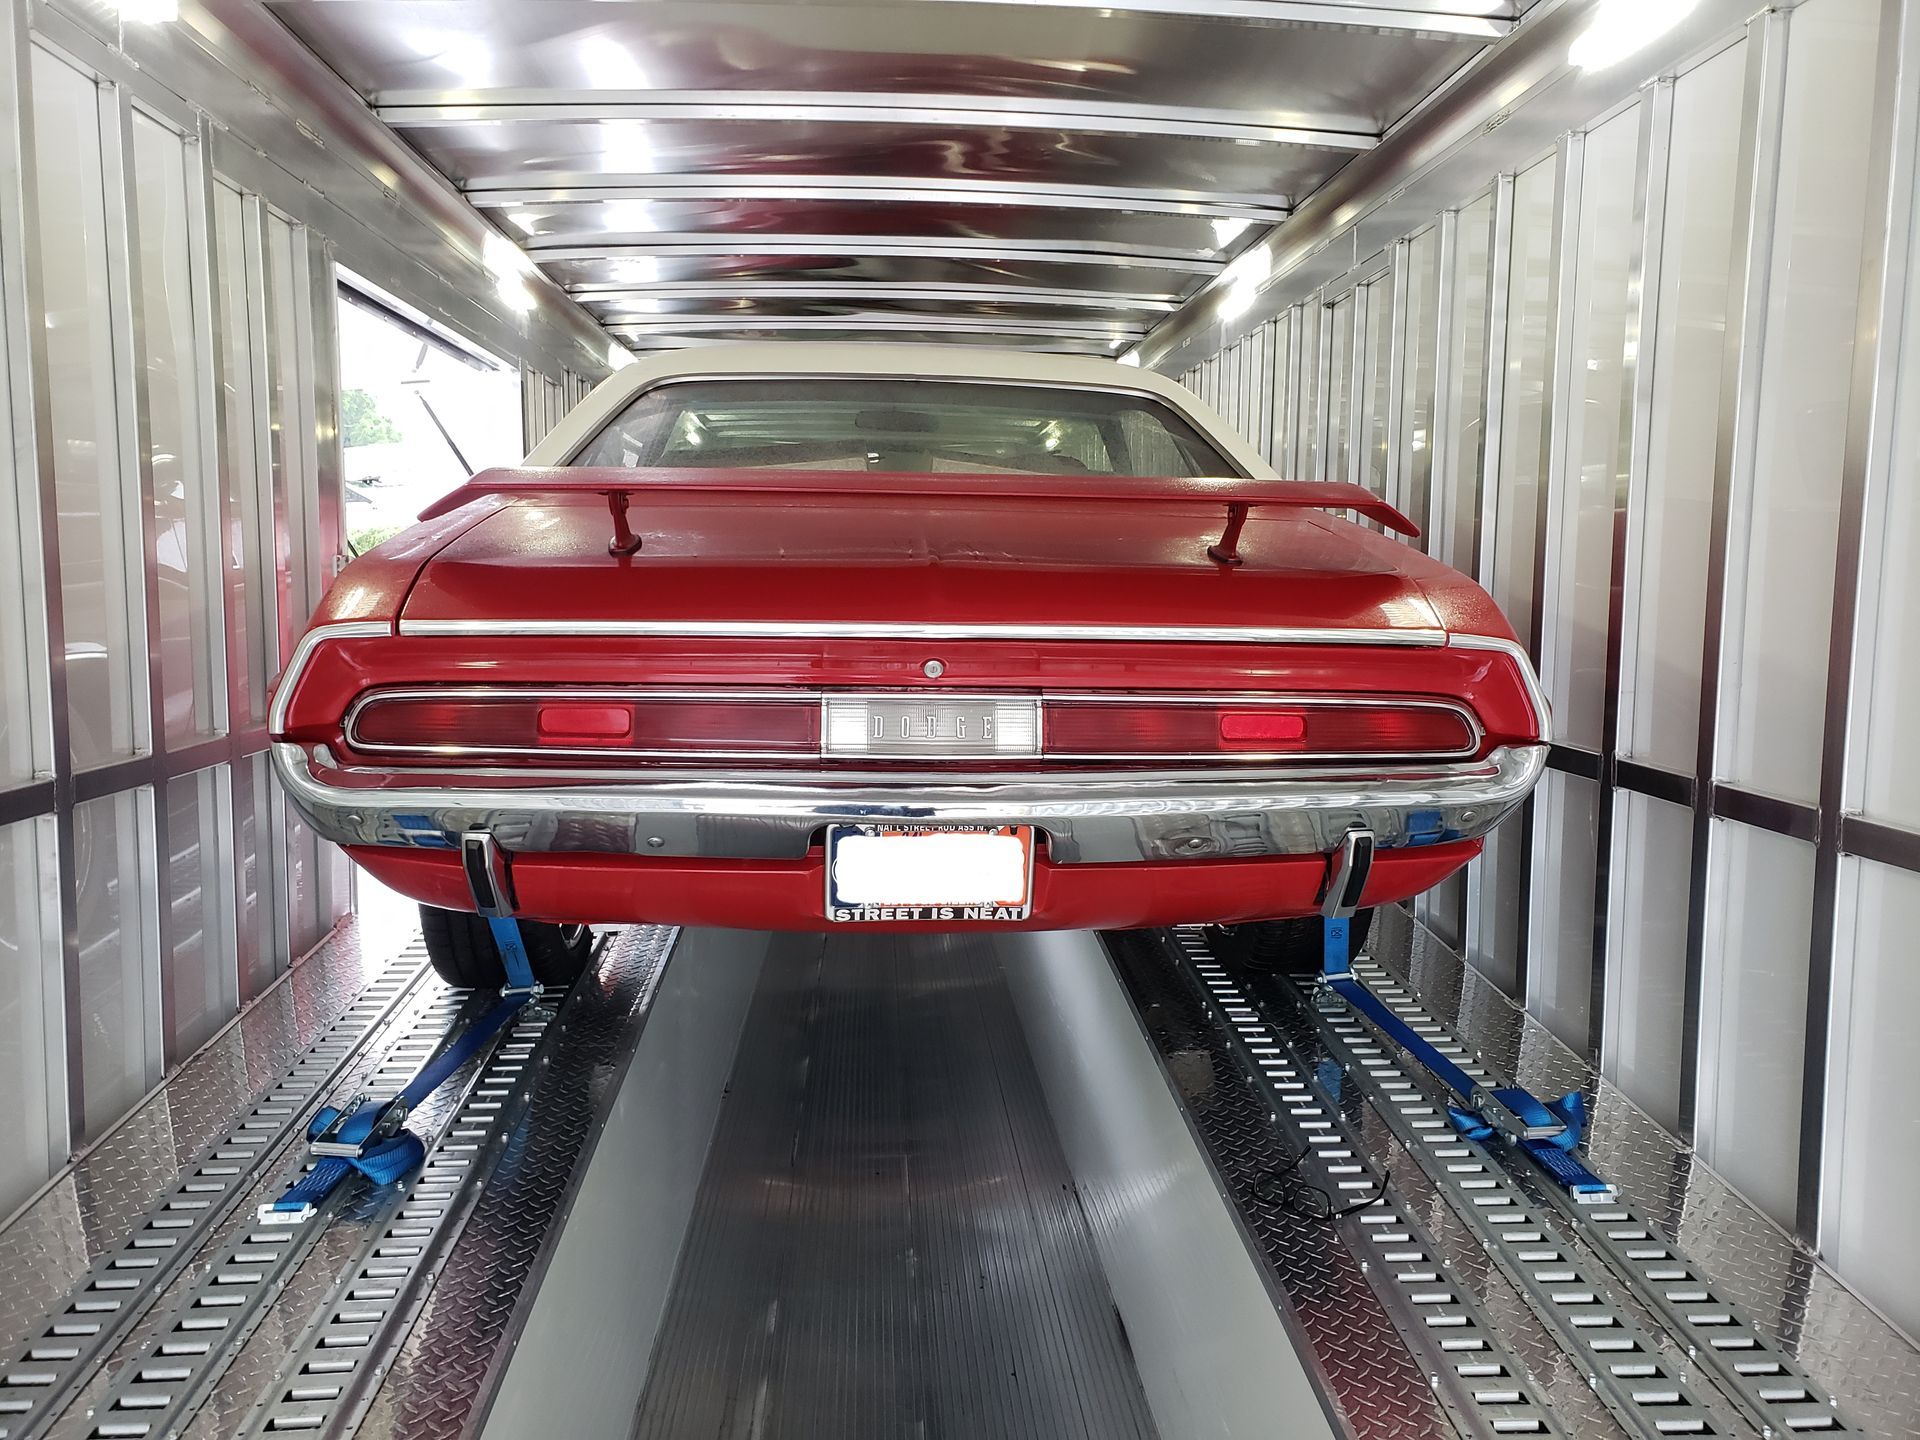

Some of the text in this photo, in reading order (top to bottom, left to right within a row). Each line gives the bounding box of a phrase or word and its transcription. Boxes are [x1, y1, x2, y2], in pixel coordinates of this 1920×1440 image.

[873, 715, 993, 739] DODGE
[835, 907, 1022, 921] STREET IS NEAT
